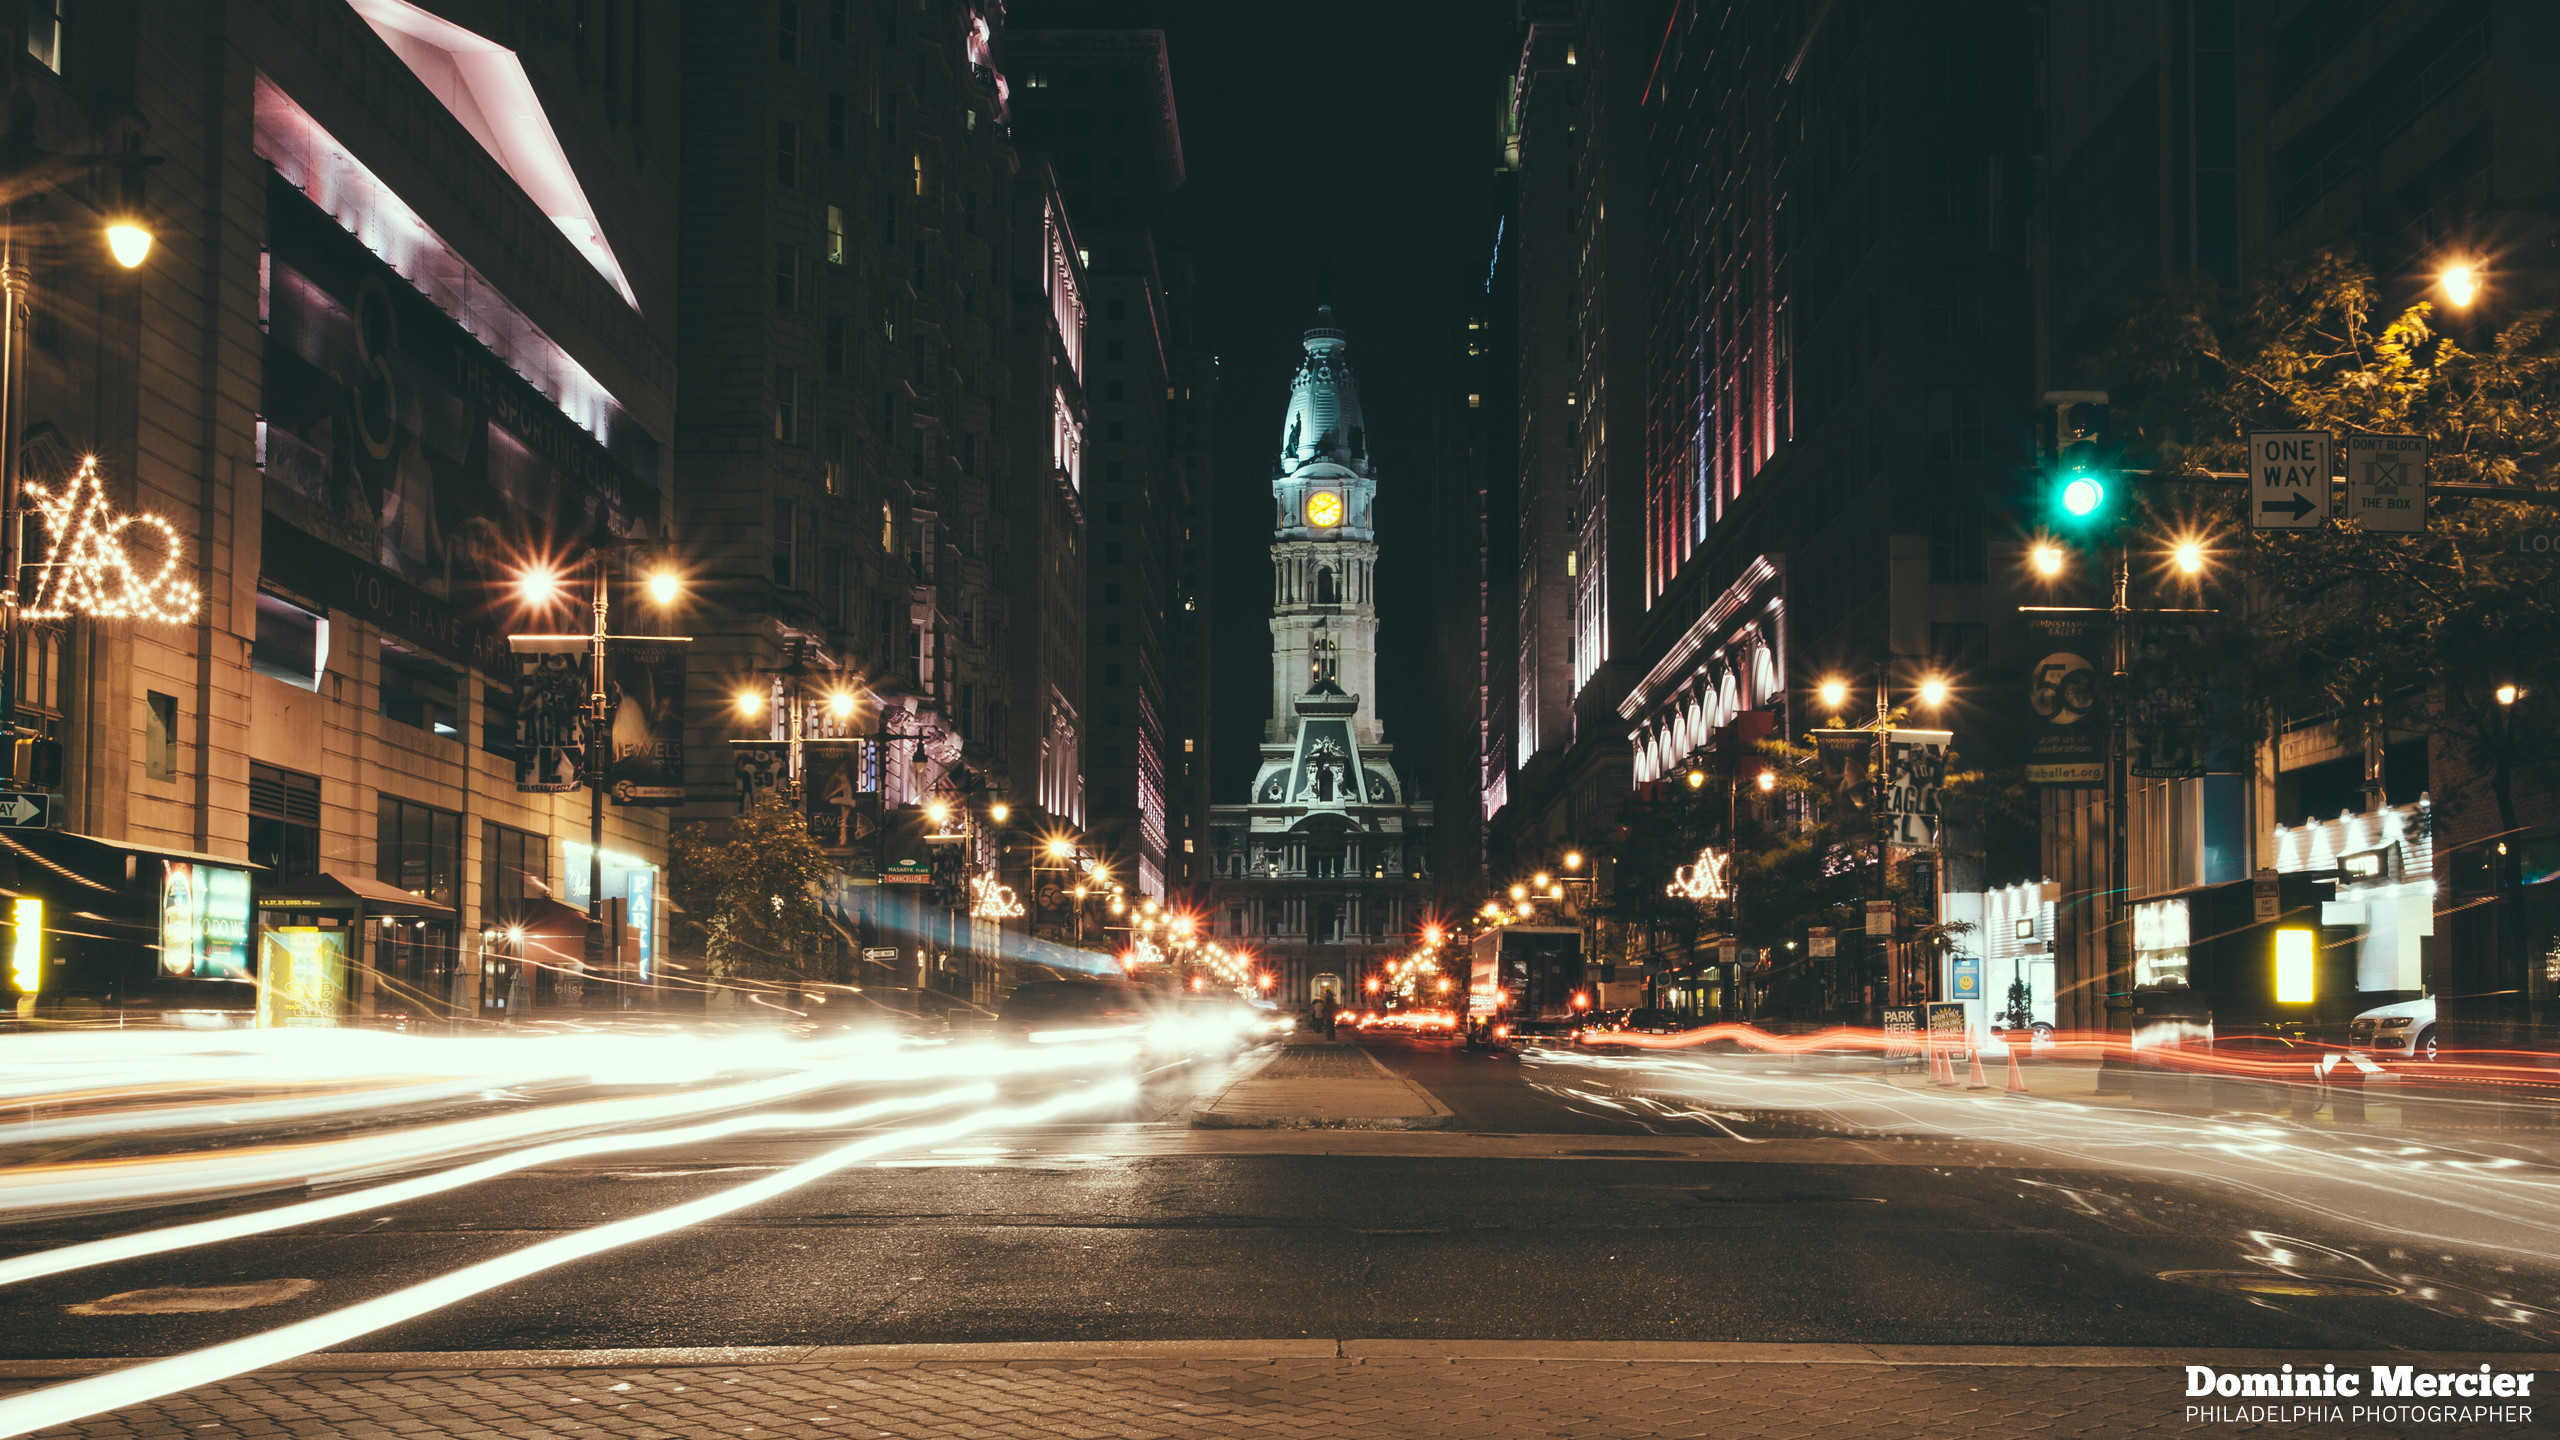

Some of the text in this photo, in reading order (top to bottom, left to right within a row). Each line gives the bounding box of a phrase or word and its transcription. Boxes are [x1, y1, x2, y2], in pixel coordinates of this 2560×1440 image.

[453, 345, 491, 405] THE
[498, 382, 581, 475] SPORTING
[585, 455, 621, 506] CLUB
[2265, 440, 2315, 461] ONE
[2352, 439, 2421, 451] DON'T BLOCK
[2263, 466, 2317, 487] WAY
[2362, 498, 2411, 510] THE BOX
[351, 567, 513, 674] YOU HAVE ARRI
[612, 742, 681, 763] JEWELS
[754, 772, 775, 787] 59
[0, 803, 16, 816] AY
[888, 875, 922, 883] CHANCELLOR
[212, 919, 229, 937] DO
[1884, 1011, 1915, 1022] PARK
[1931, 1009, 1960, 1022] MONTHLY
[1885, 1023, 1916, 1034] HERE
[1933, 1018, 1962, 1030] PARKING
